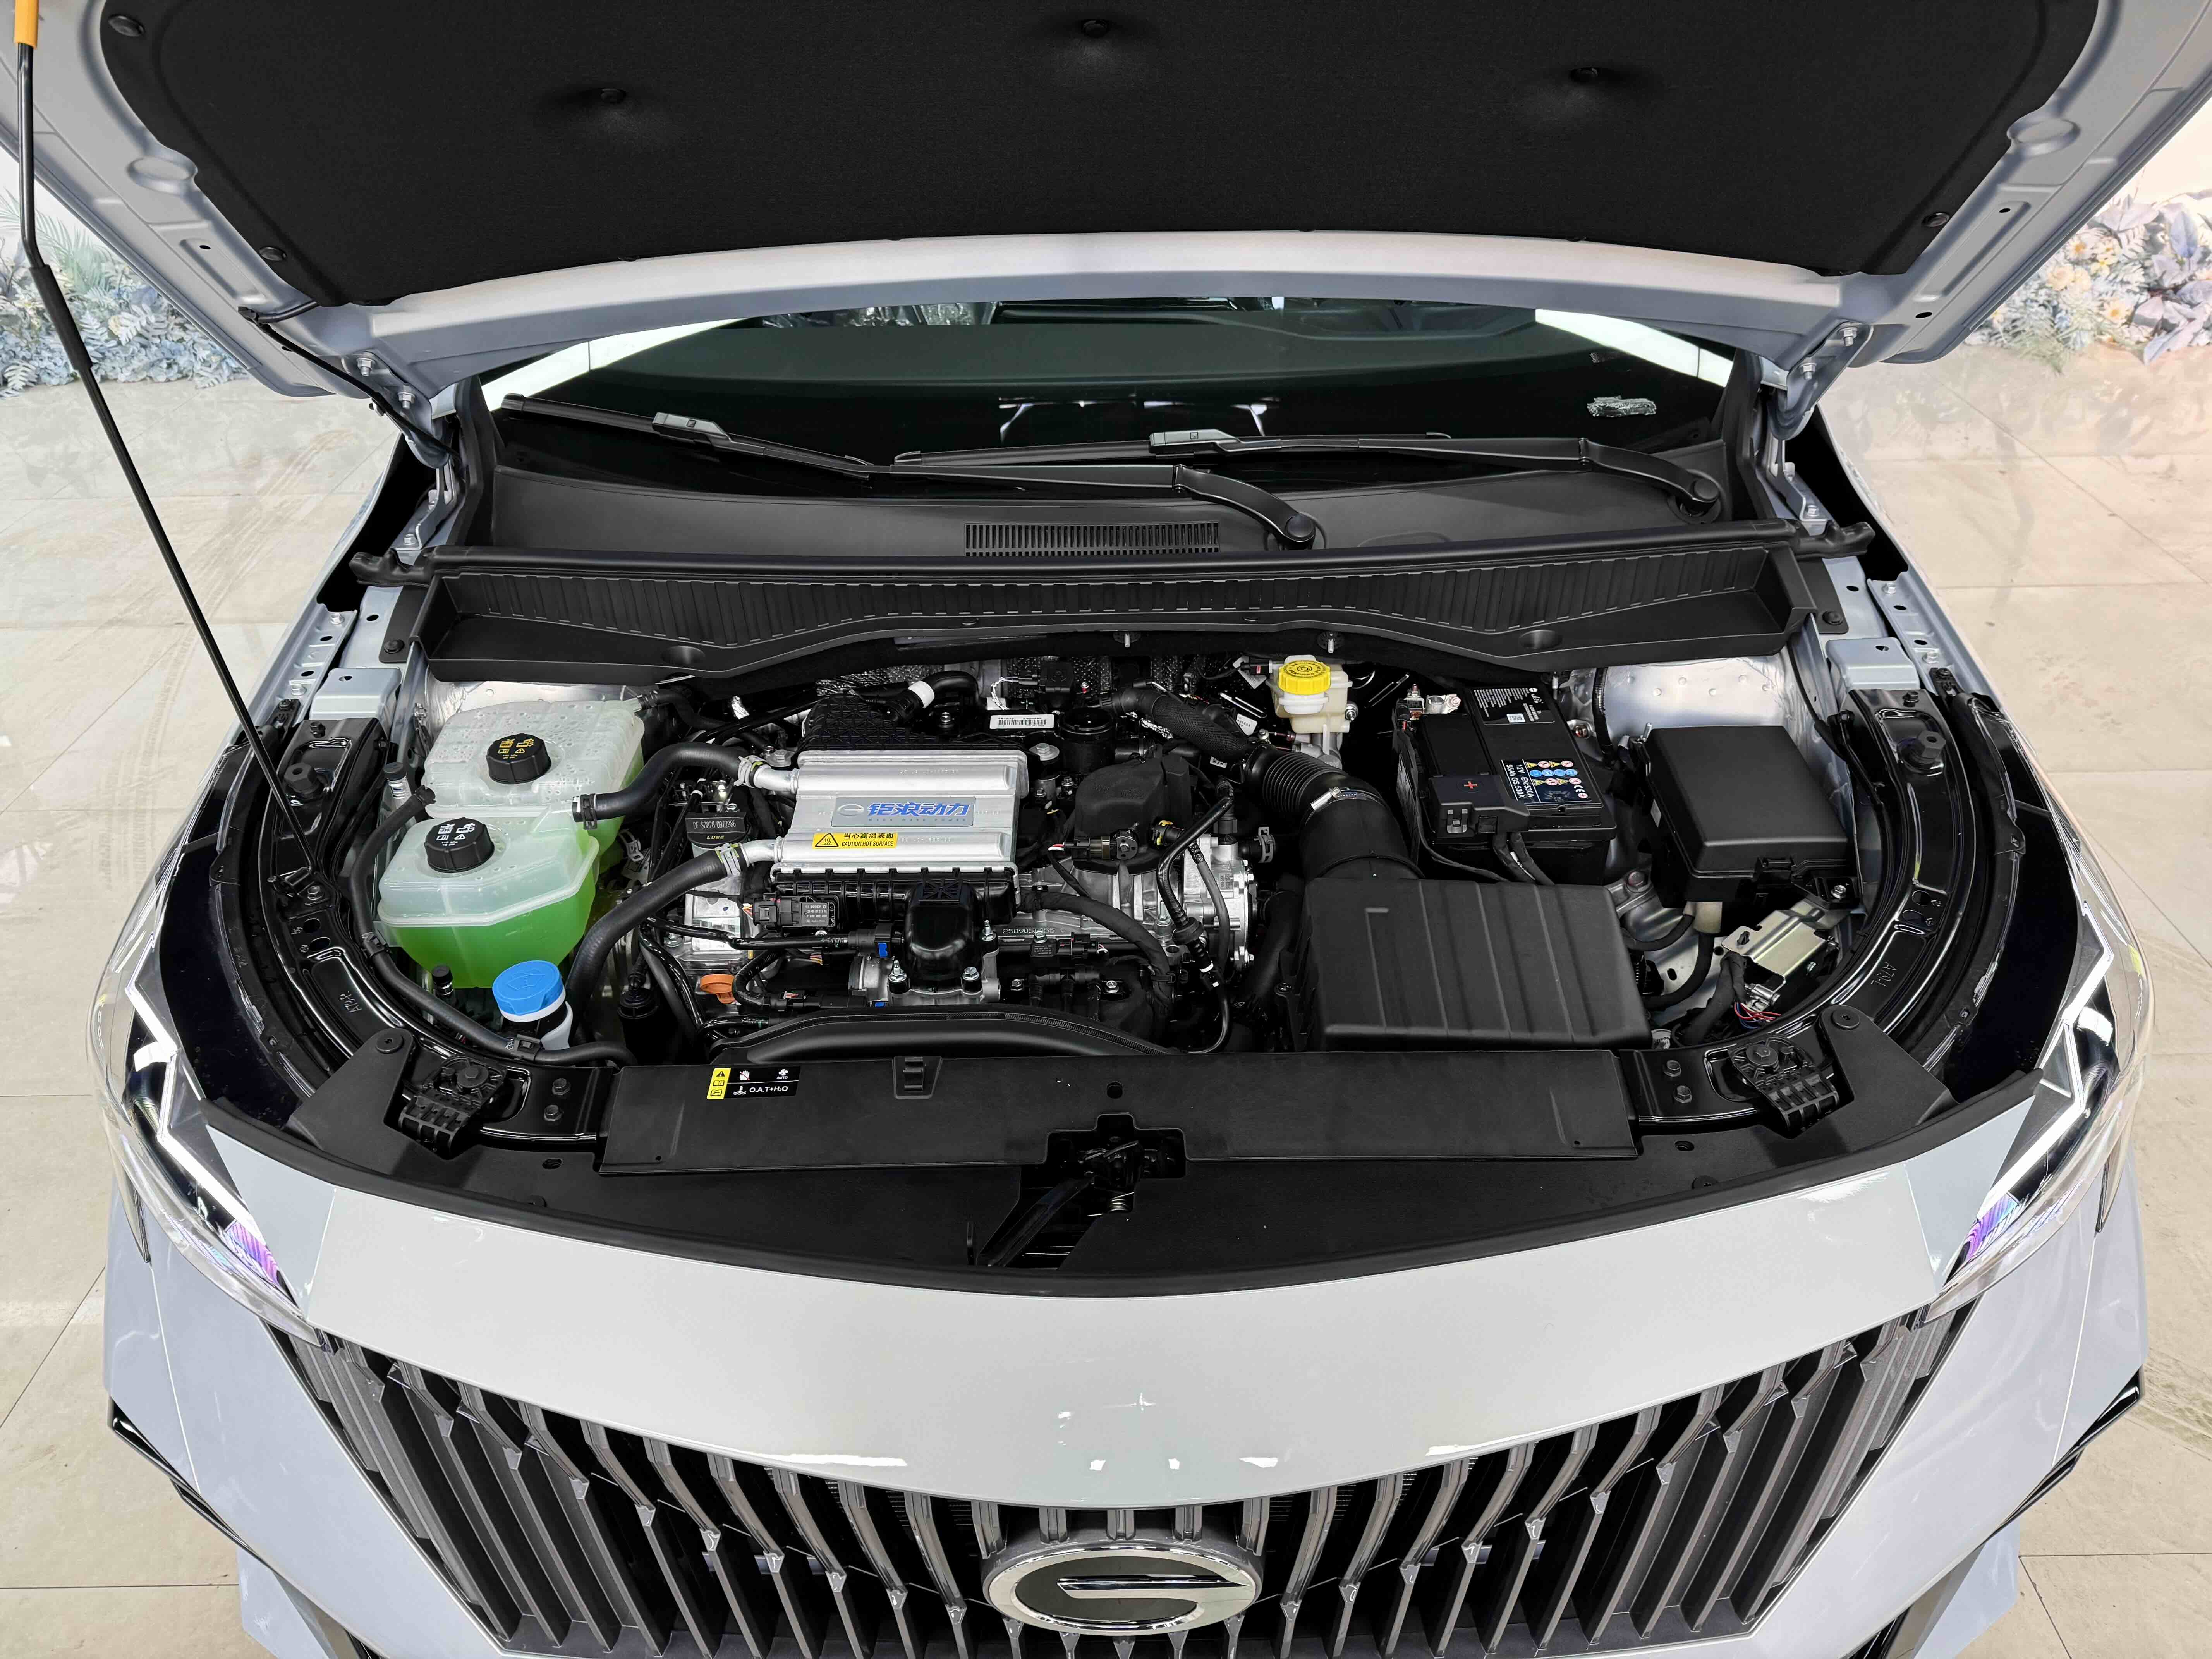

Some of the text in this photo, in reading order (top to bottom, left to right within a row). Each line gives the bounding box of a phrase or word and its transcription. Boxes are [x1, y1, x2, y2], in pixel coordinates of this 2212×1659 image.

[1506, 764, 1525, 798] 55Ah GS:530A
[1516, 764, 1535, 798] 12V EN:530A
[867, 802, 970, 817] 钜浪动力
